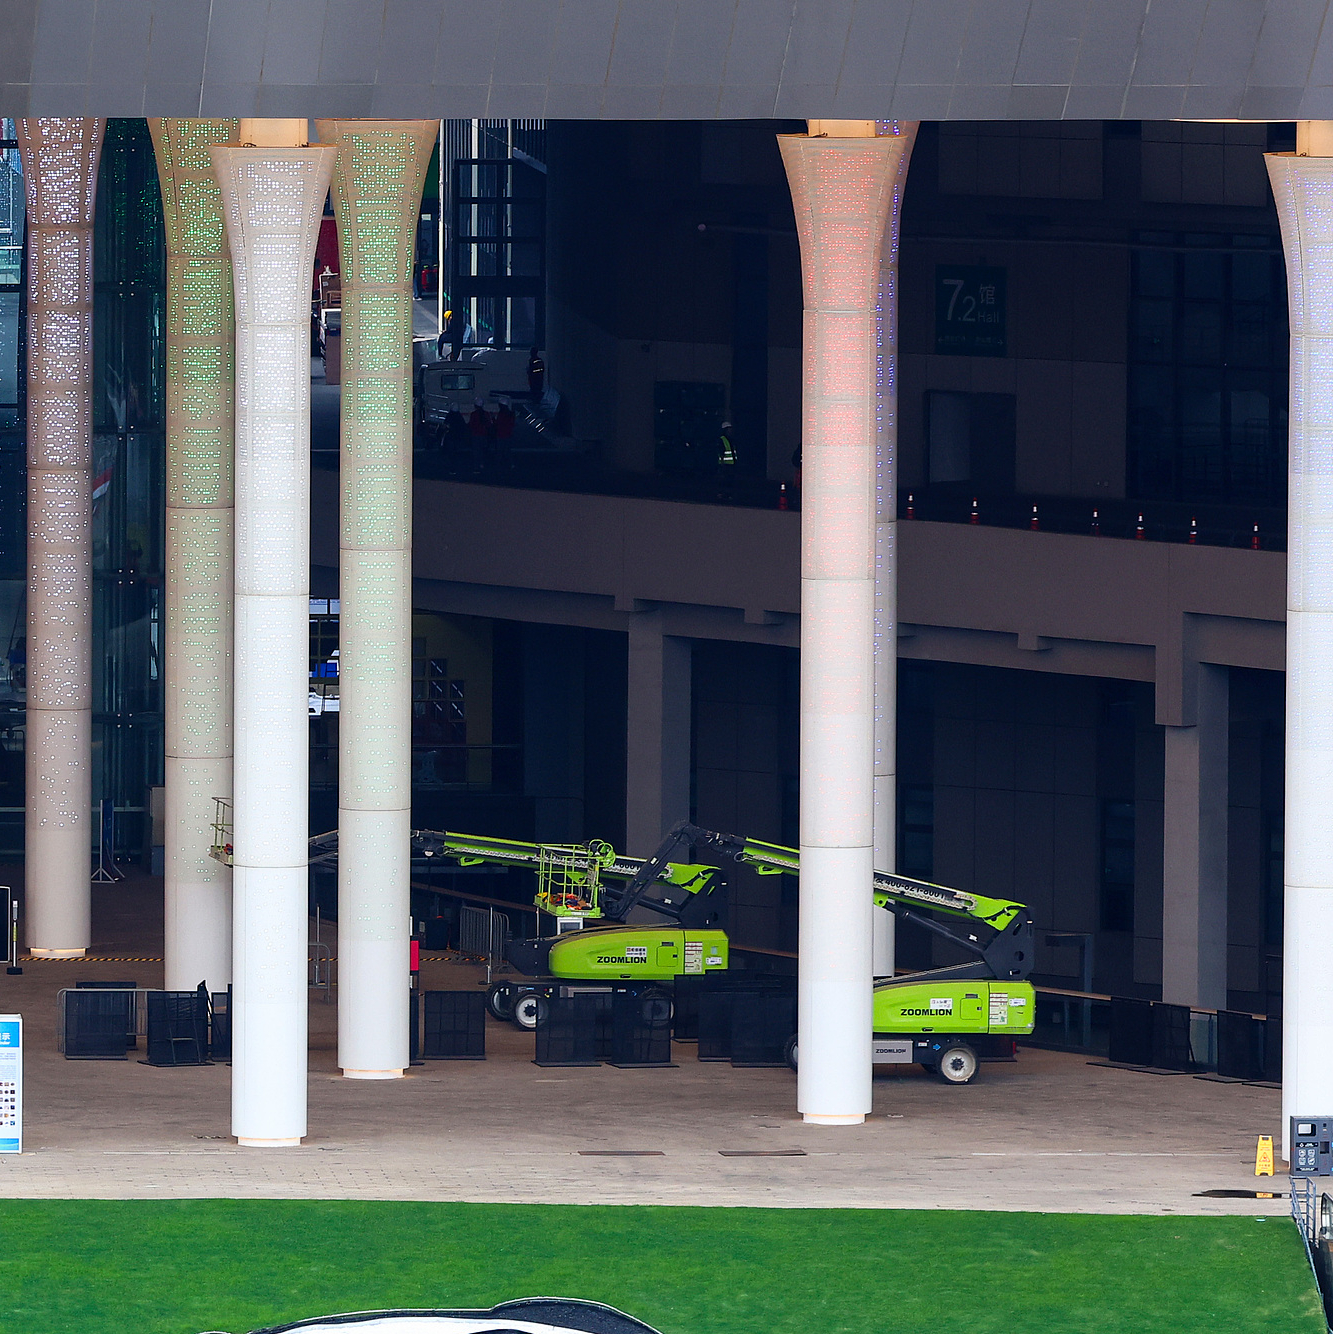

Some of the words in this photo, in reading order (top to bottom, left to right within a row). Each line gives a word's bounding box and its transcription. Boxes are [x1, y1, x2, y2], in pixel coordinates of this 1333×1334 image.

[942, 278, 976, 322] 7.2
[979, 283, 996, 305] 馆
[978, 311, 999, 324] Hall
[596, 956, 647, 964] ZOOMLION
[900, 1008, 953, 1016] ZOOMLION
